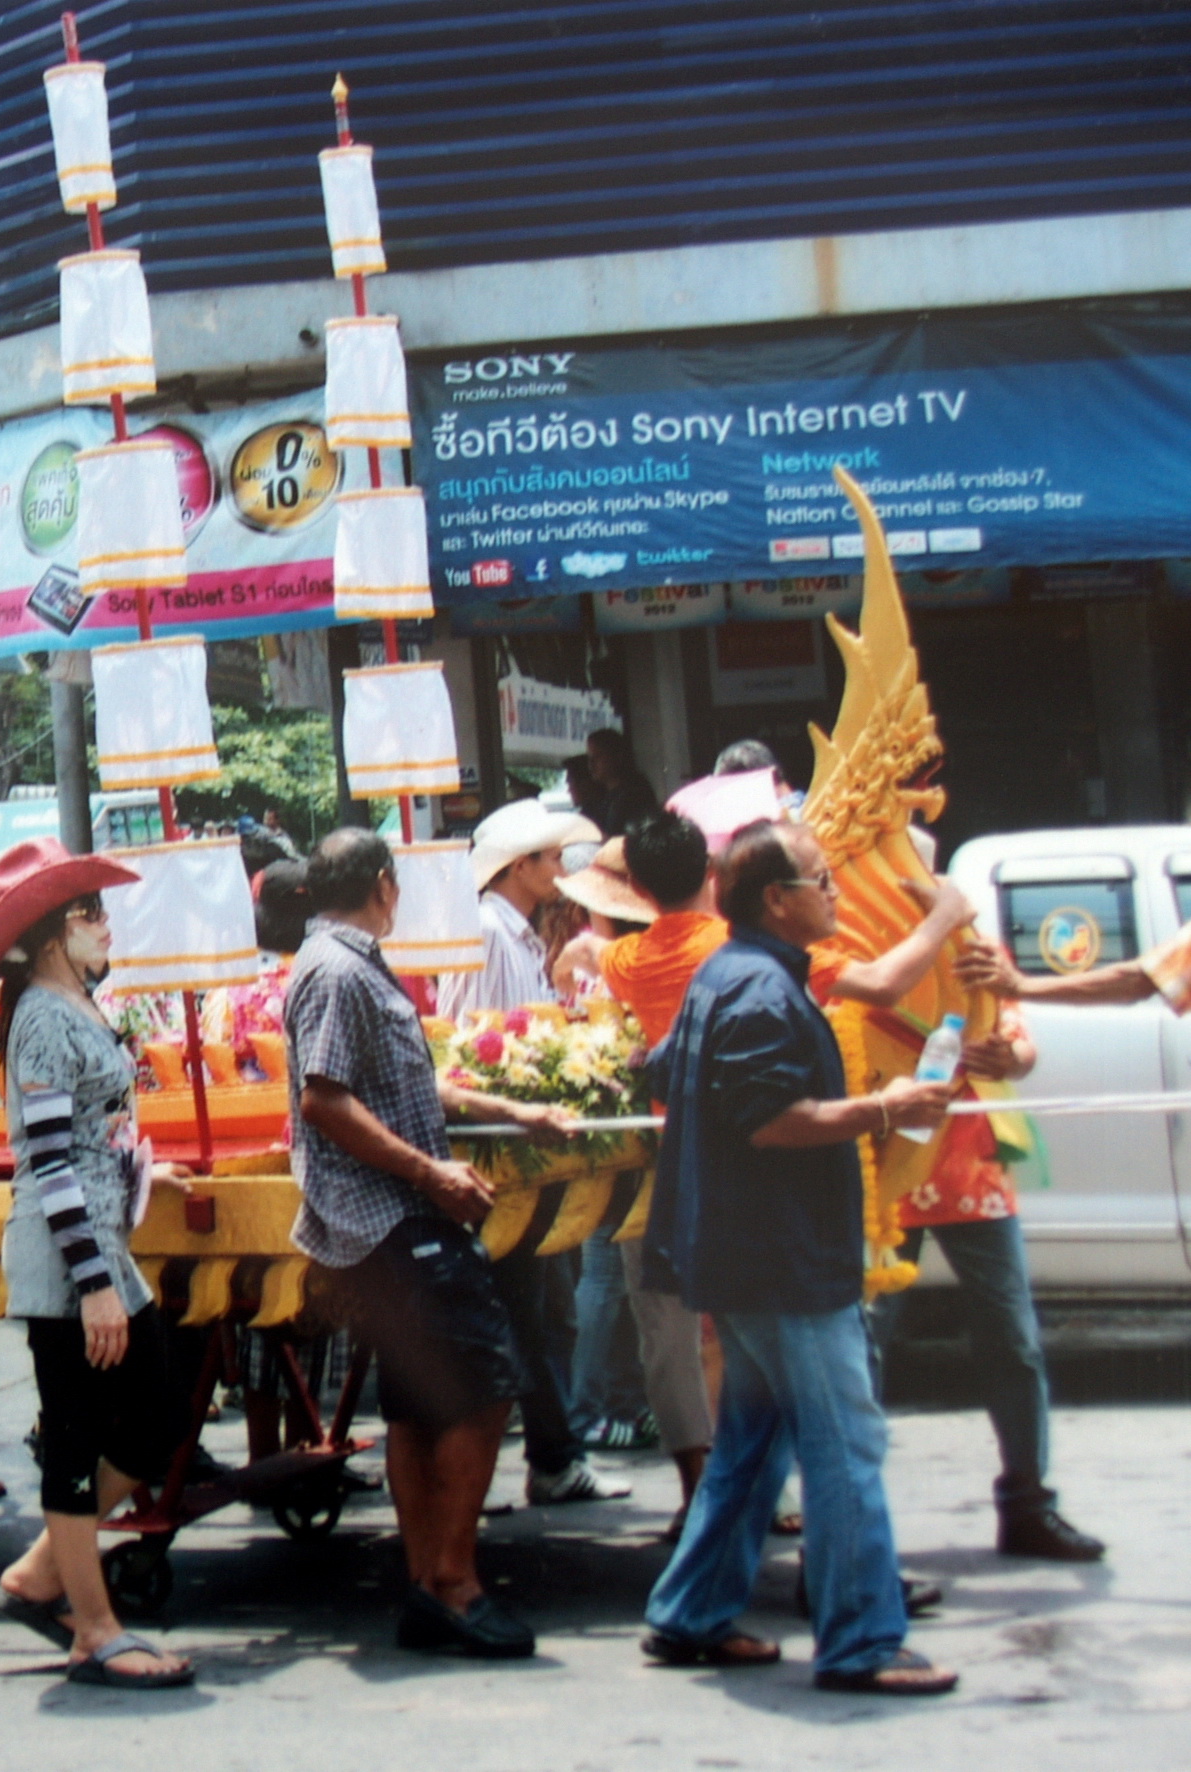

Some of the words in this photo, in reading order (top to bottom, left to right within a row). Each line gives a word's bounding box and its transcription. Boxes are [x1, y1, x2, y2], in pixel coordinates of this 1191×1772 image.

[444, 352, 575, 384] SONY
[453, 382, 567, 402] make.believe
[432, 411, 618, 461] ซื้อทีวีต้อง
[631, 412, 733, 446] Sony
[746, 394, 908, 437] Internet
[917, 390, 966, 424] TV
[762, 446, 882, 475] Network
[262, 475, 300, 511] 10
[439, 453, 690, 504] สนุกกับสังคมออนไลน์
[491, 496, 599, 523] Facebook
[664, 489, 729, 511] Skype
[766, 505, 837, 526] Nation
[841, 498, 932, 522] Cannel
[967, 493, 1040, 514] Gossip
[1043, 491, 1084, 510] Star
[470, 527, 533, 550] Twitter
[162, 585, 224, 610] Tablet
[230, 582, 258, 605] S1
